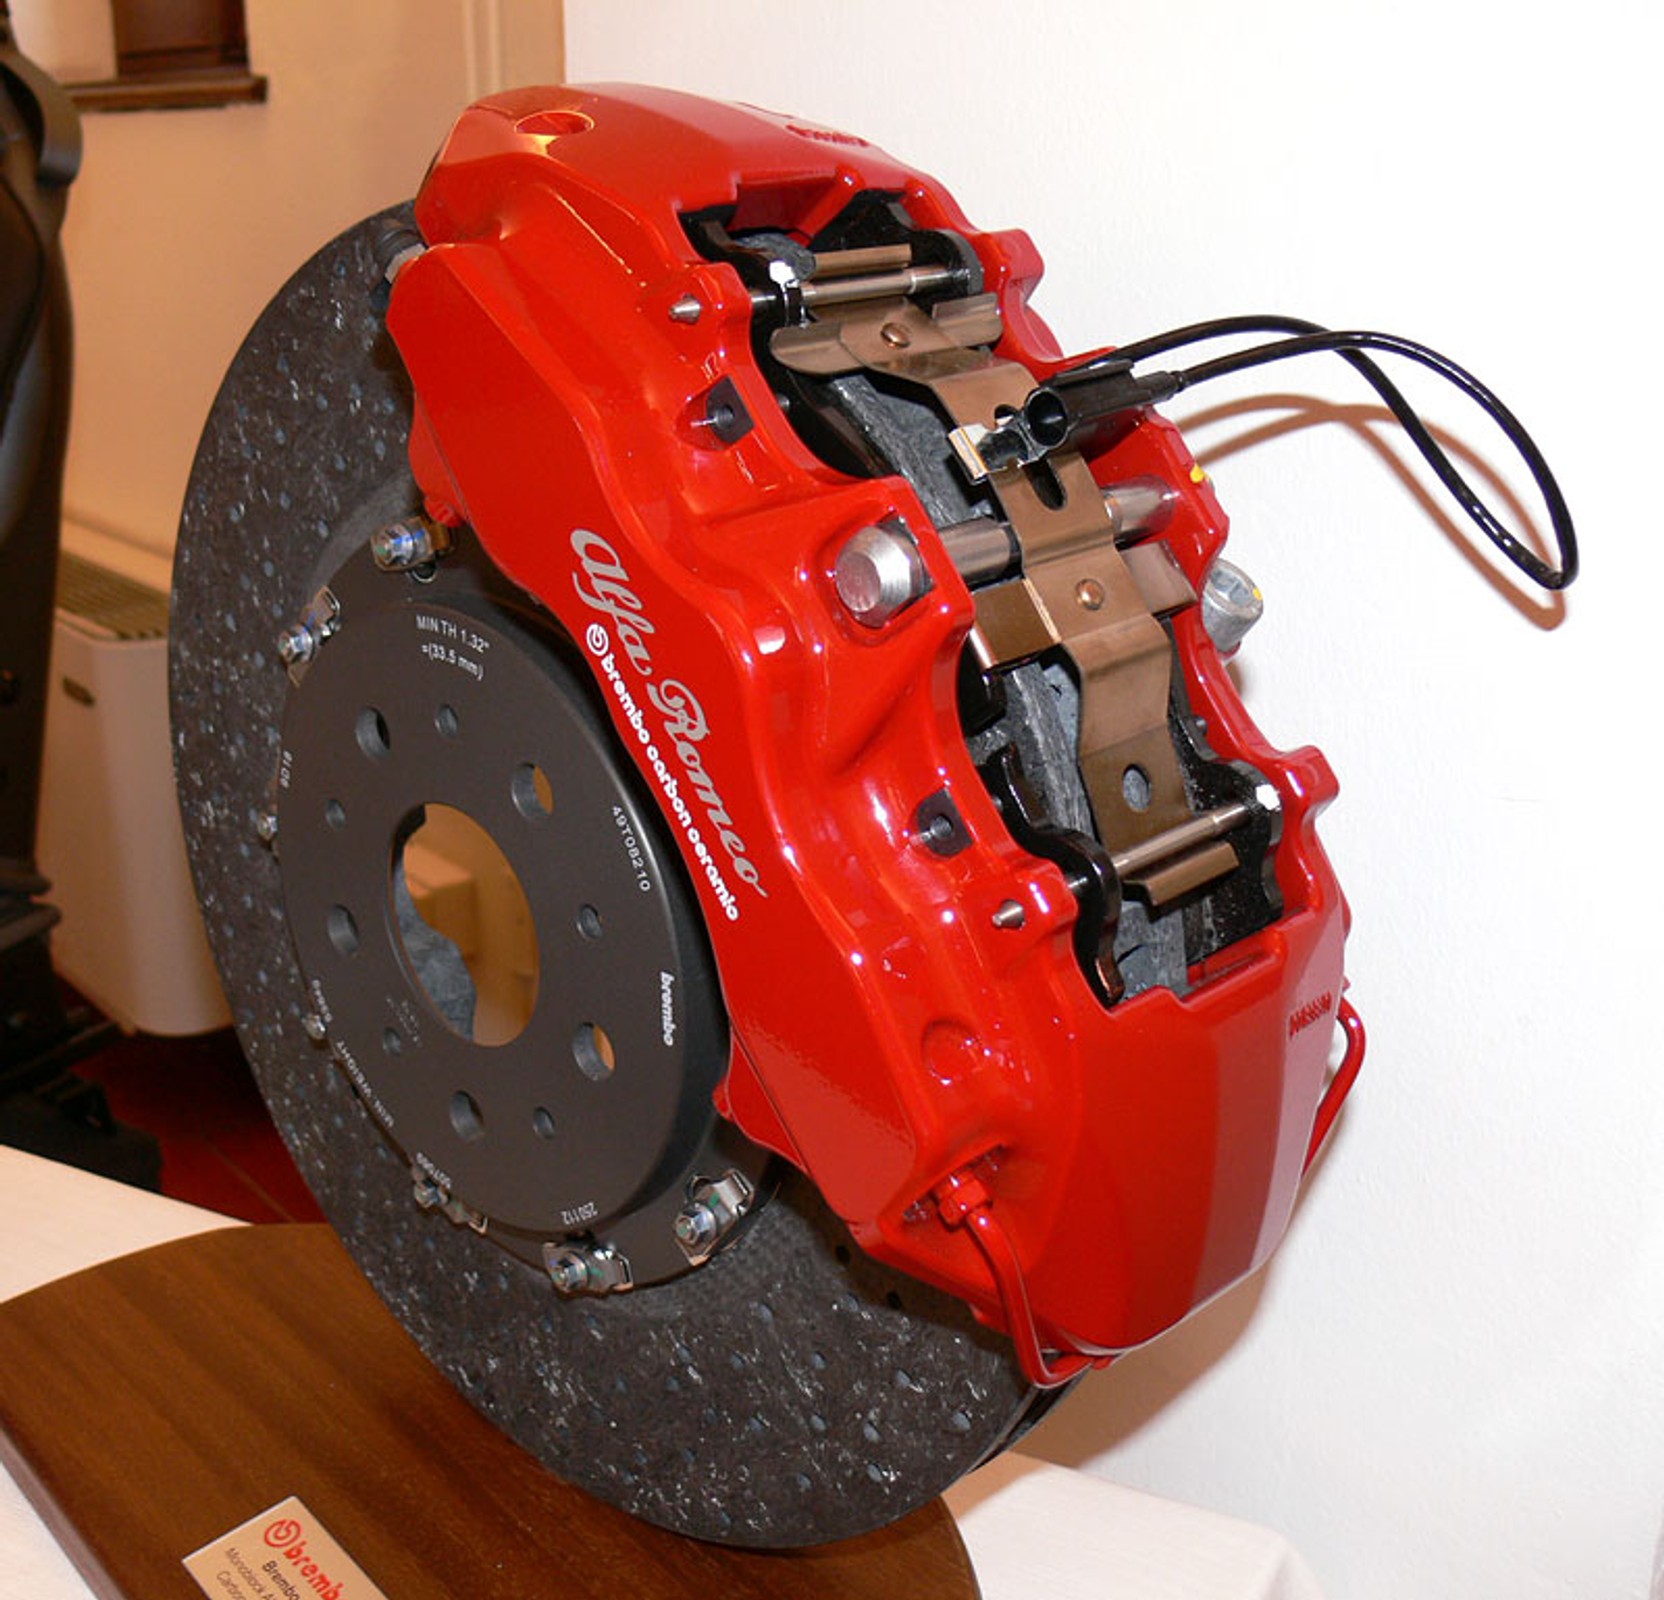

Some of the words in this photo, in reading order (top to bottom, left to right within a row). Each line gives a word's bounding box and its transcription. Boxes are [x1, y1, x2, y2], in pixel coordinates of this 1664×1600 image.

[416, 613, 439, 633] MIN
[440, 618, 457, 639] TH
[601, 652, 651, 744] brembo
[646, 744, 692, 828] carbon
[687, 827, 739, 921] ceramic
[646, 678, 768, 898] Romeo
[660, 971, 677, 1046] brembo
[283, 1540, 347, 1600] bremb
